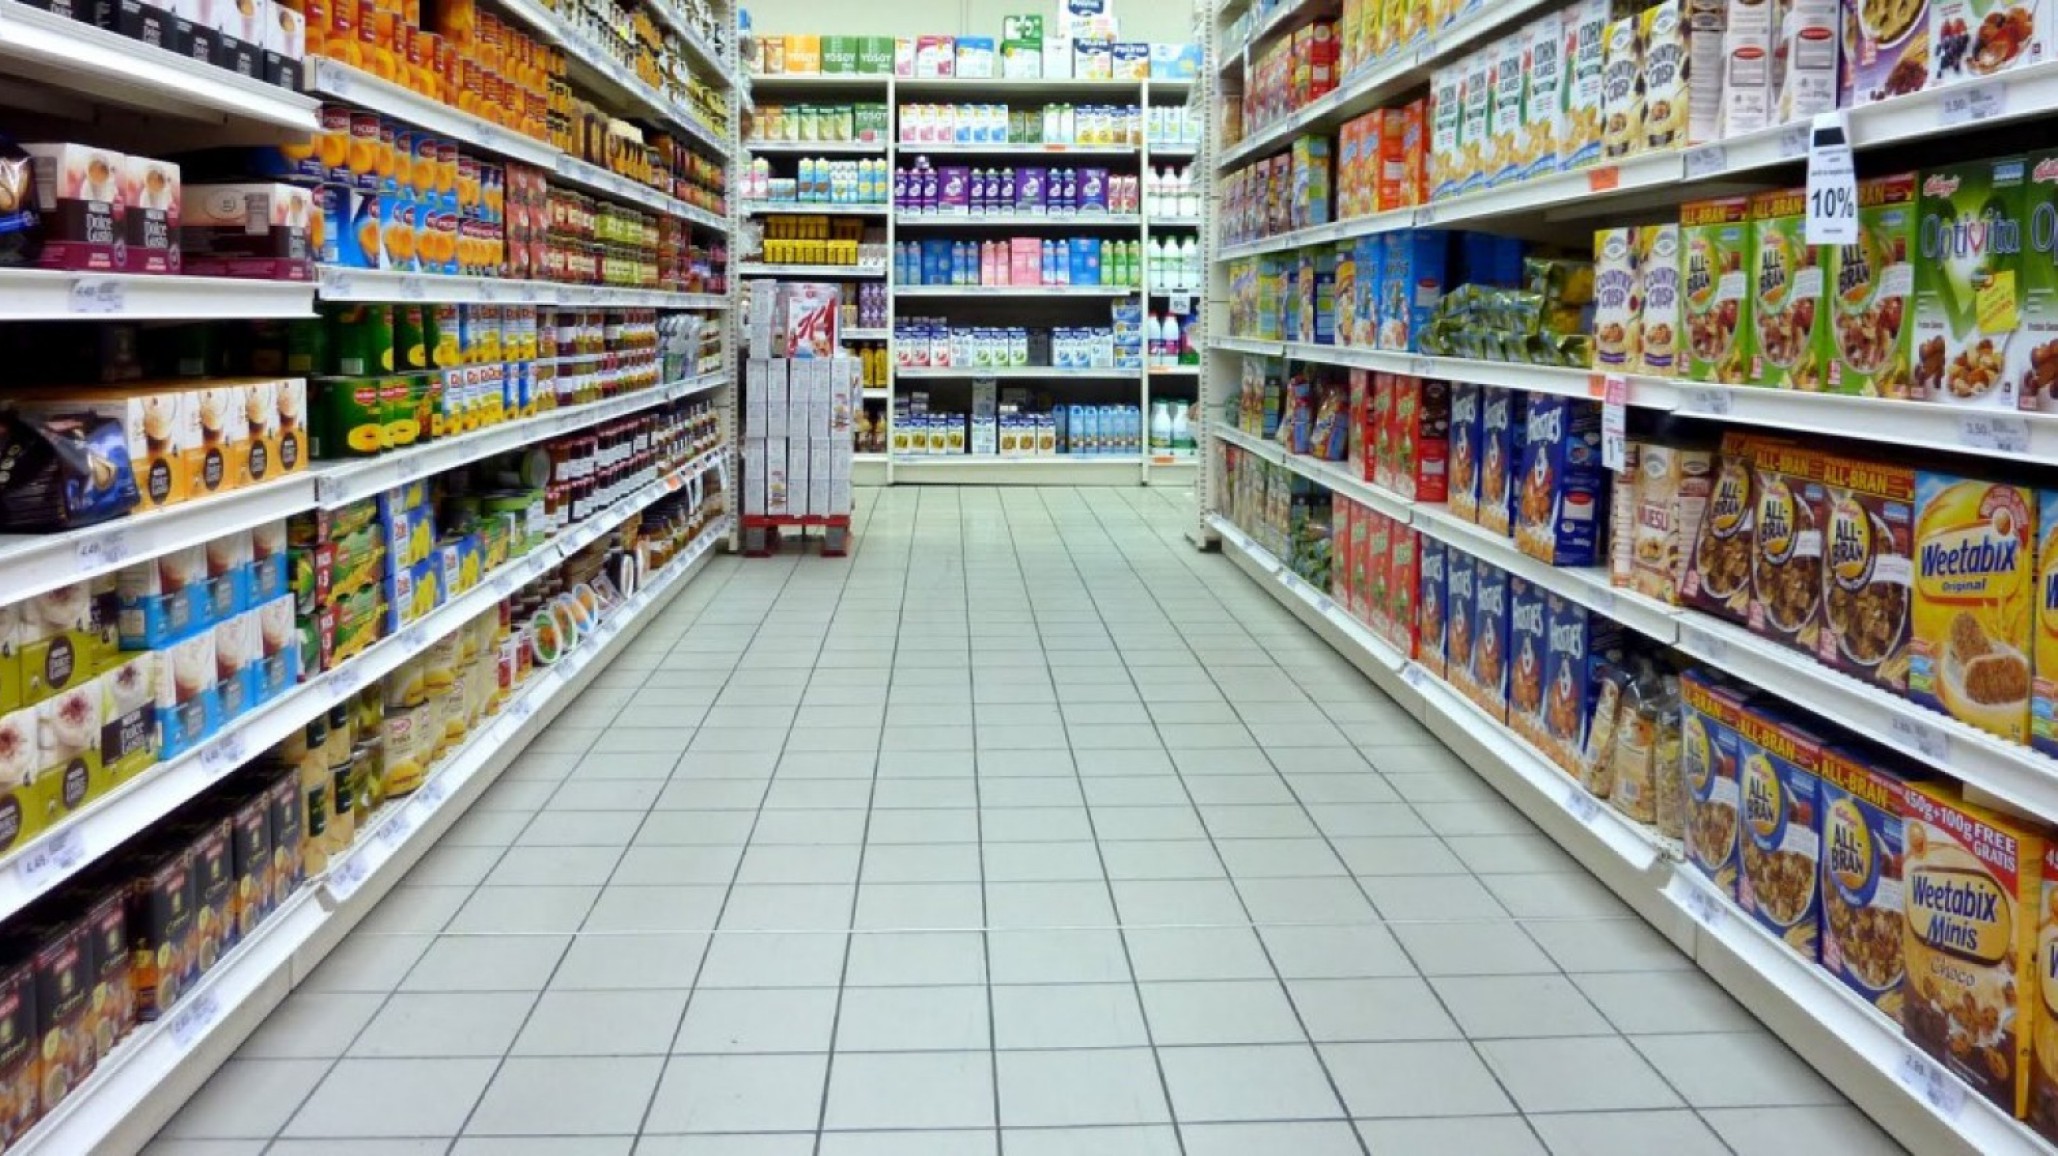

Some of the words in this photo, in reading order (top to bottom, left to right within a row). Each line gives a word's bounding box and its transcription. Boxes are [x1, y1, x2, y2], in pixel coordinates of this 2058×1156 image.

[1811, 187, 1854, 219] 10%
[1823, 463, 1888, 494] ALL-BRAN
[1765, 499, 1788, 520] ALL-
[1760, 519, 1788, 542] BRAN
[1836, 518, 1862, 542] ALL-
[1831, 540, 1864, 565] BRAN
[1922, 534, 2017, 577] Weetabix
[1942, 578, 1986, 592] Original
[1736, 717, 1797, 764] ALL-BRAN
[1751, 775, 1773, 803] ALL-
[1822, 759, 1889, 811] ALL-BRAN
[1748, 797, 1774, 822] BRAN
[1904, 792, 1975, 843] 450g+100g
[1975, 821, 2016, 854] FREE
[1835, 823, 1863, 854] ALL-
[1831, 846, 1864, 878] BRAN
[1973, 840, 2016, 874] GRATIS
[1911, 875, 1998, 924] Weetabix
[1926, 913, 1979, 951] Minis
[1930, 956, 1976, 988] Choco
